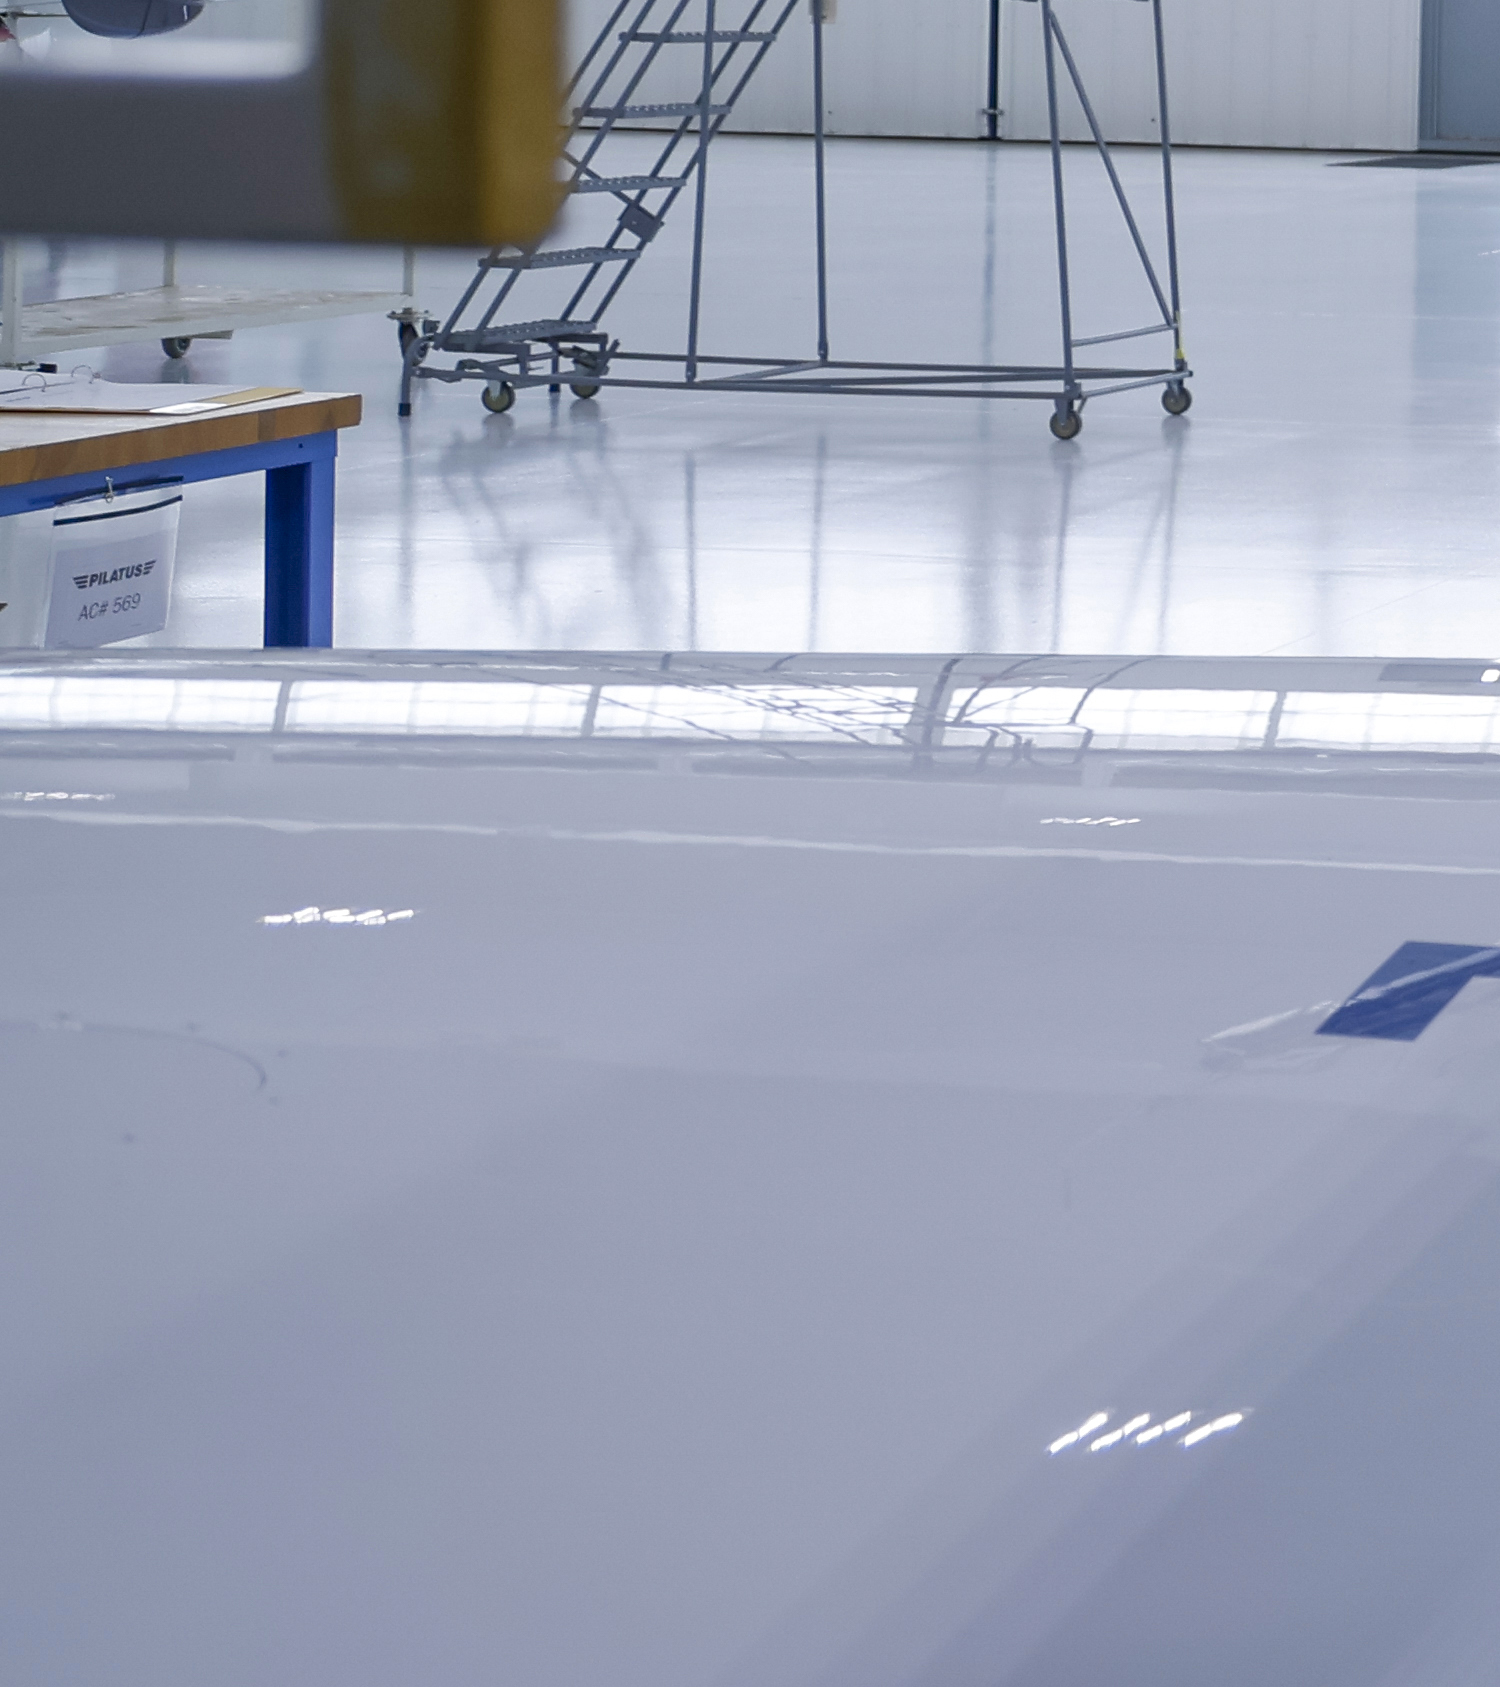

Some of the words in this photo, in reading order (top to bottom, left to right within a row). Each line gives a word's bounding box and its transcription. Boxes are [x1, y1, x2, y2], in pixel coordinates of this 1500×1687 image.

[89, 564, 143, 587] PILATUS
[78, 600, 109, 621] AC#
[112, 593, 141, 614] 569
